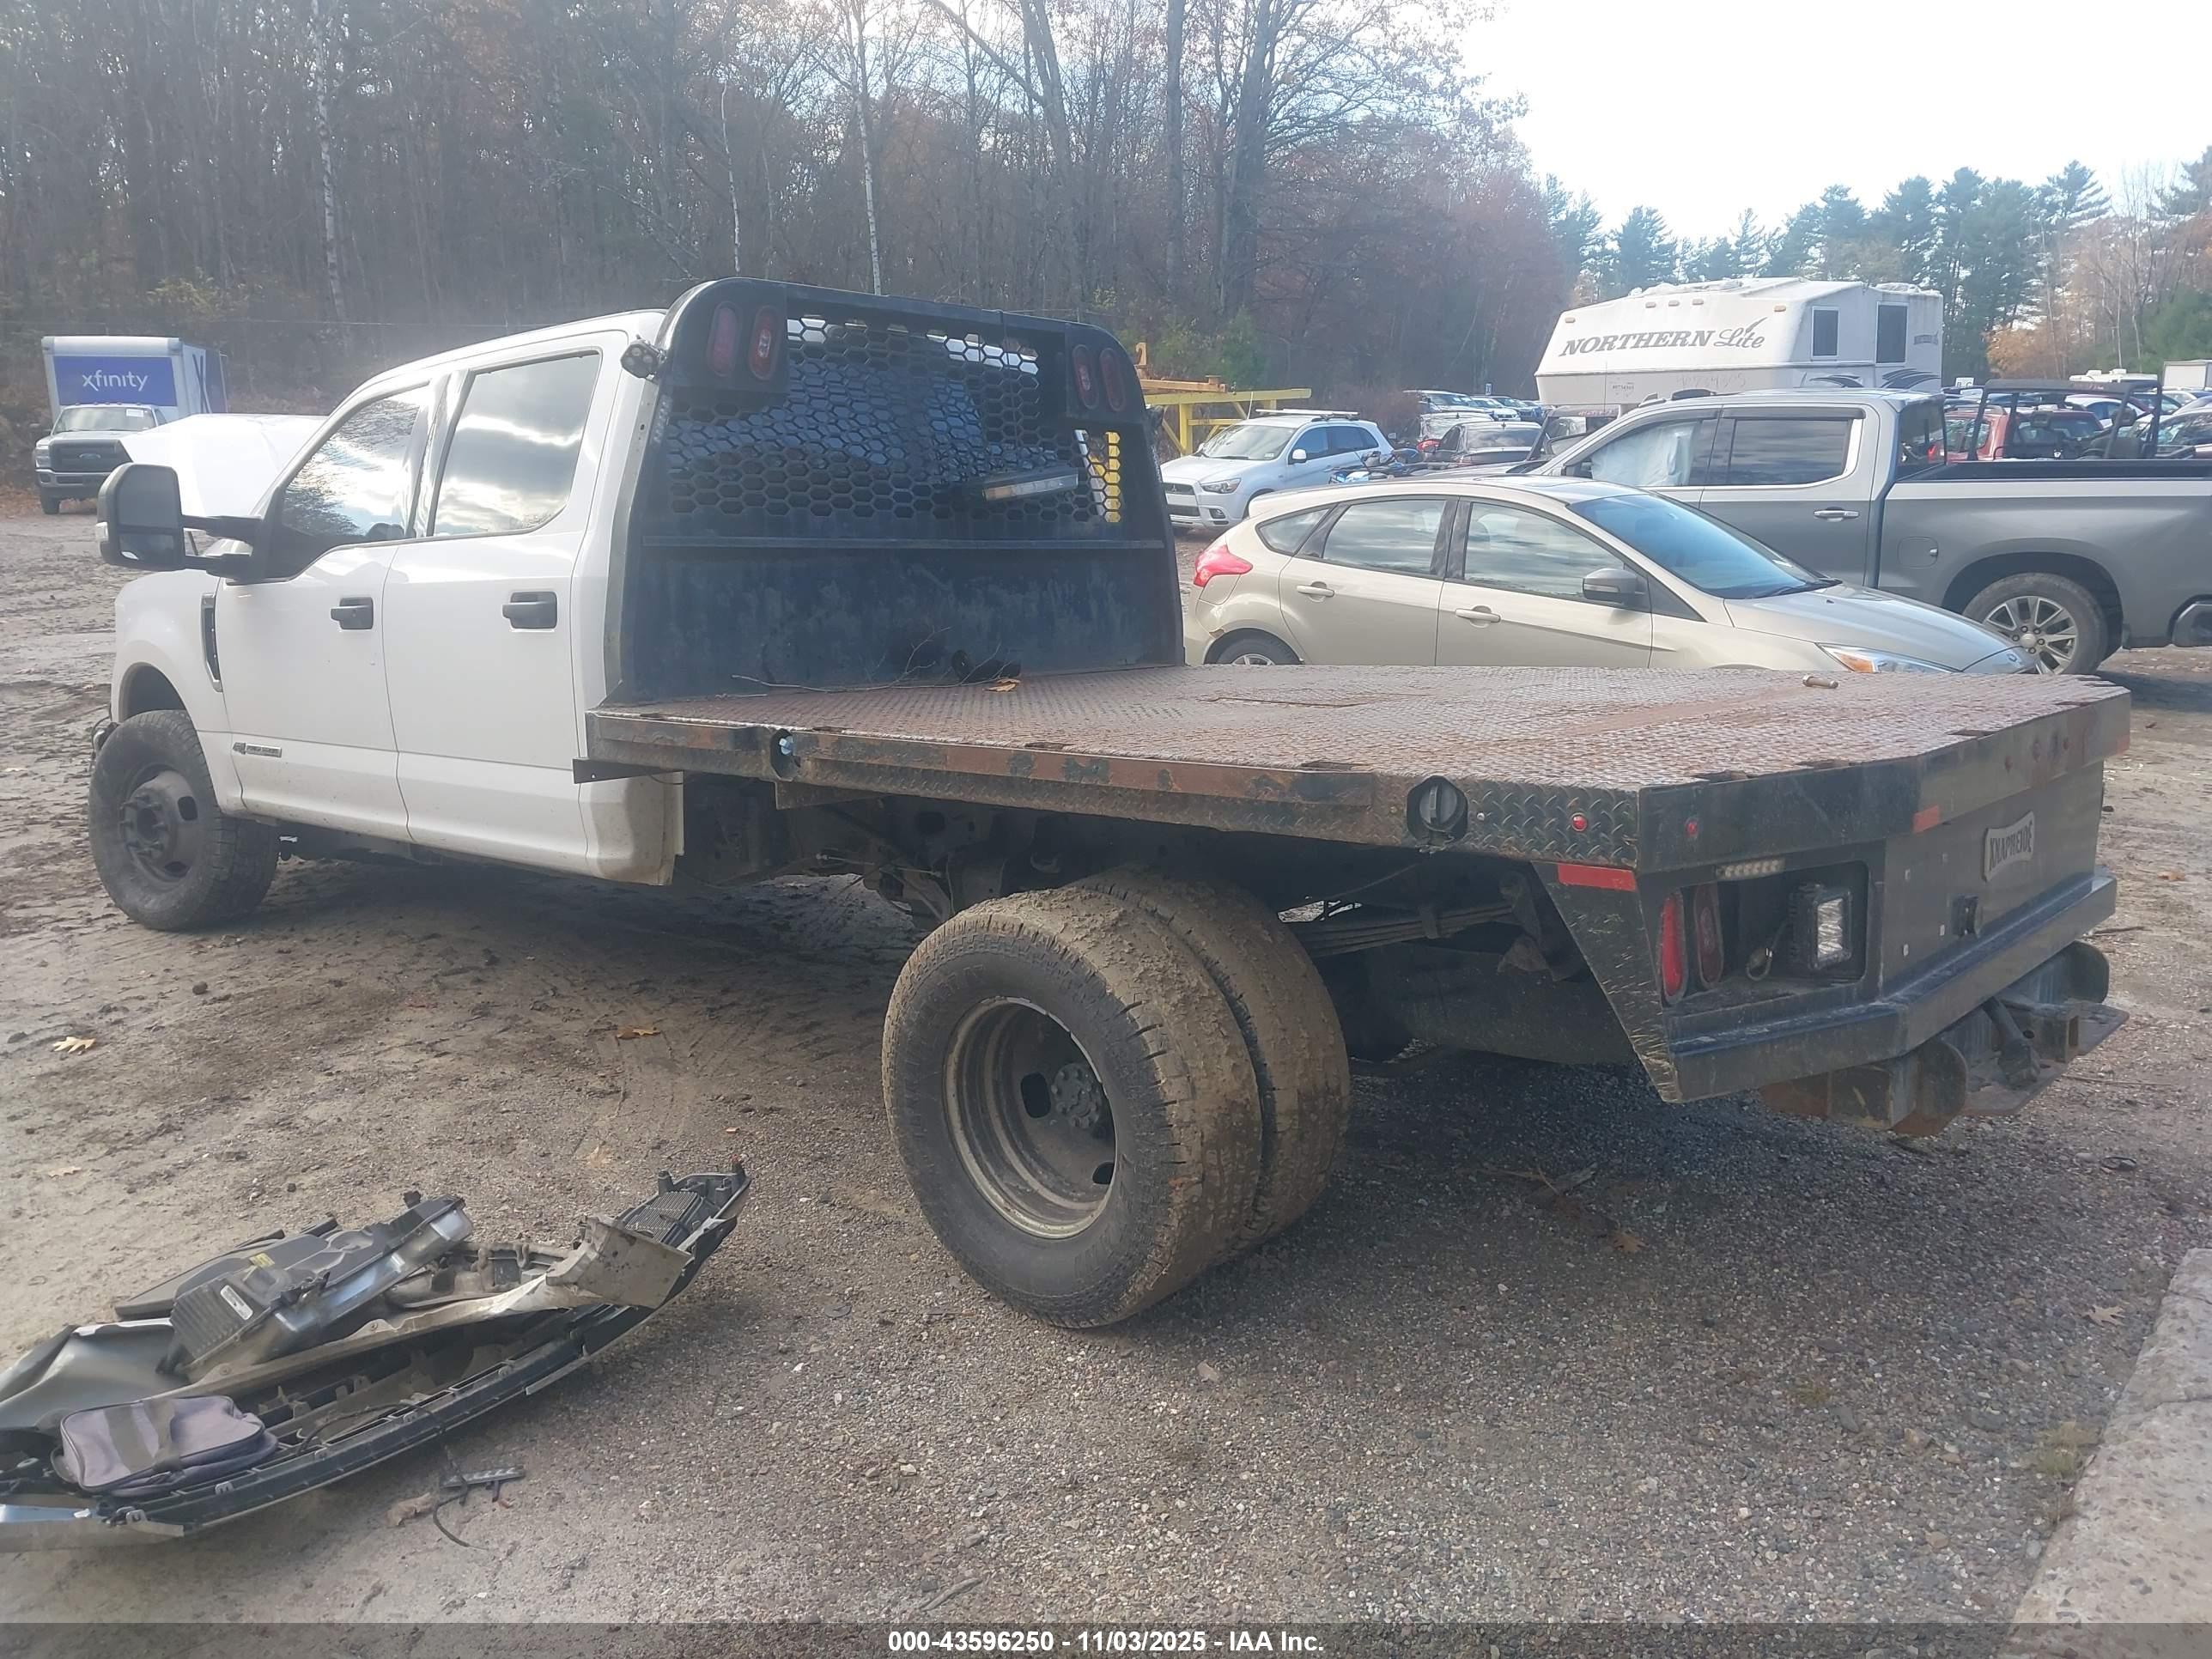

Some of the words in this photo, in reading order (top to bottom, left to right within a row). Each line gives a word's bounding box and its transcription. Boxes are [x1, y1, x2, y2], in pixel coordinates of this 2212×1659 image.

[1559, 330, 1716, 356] NORTHERN
[1713, 317, 1767, 349] Lite
[82, 369, 148, 392] xfinity
